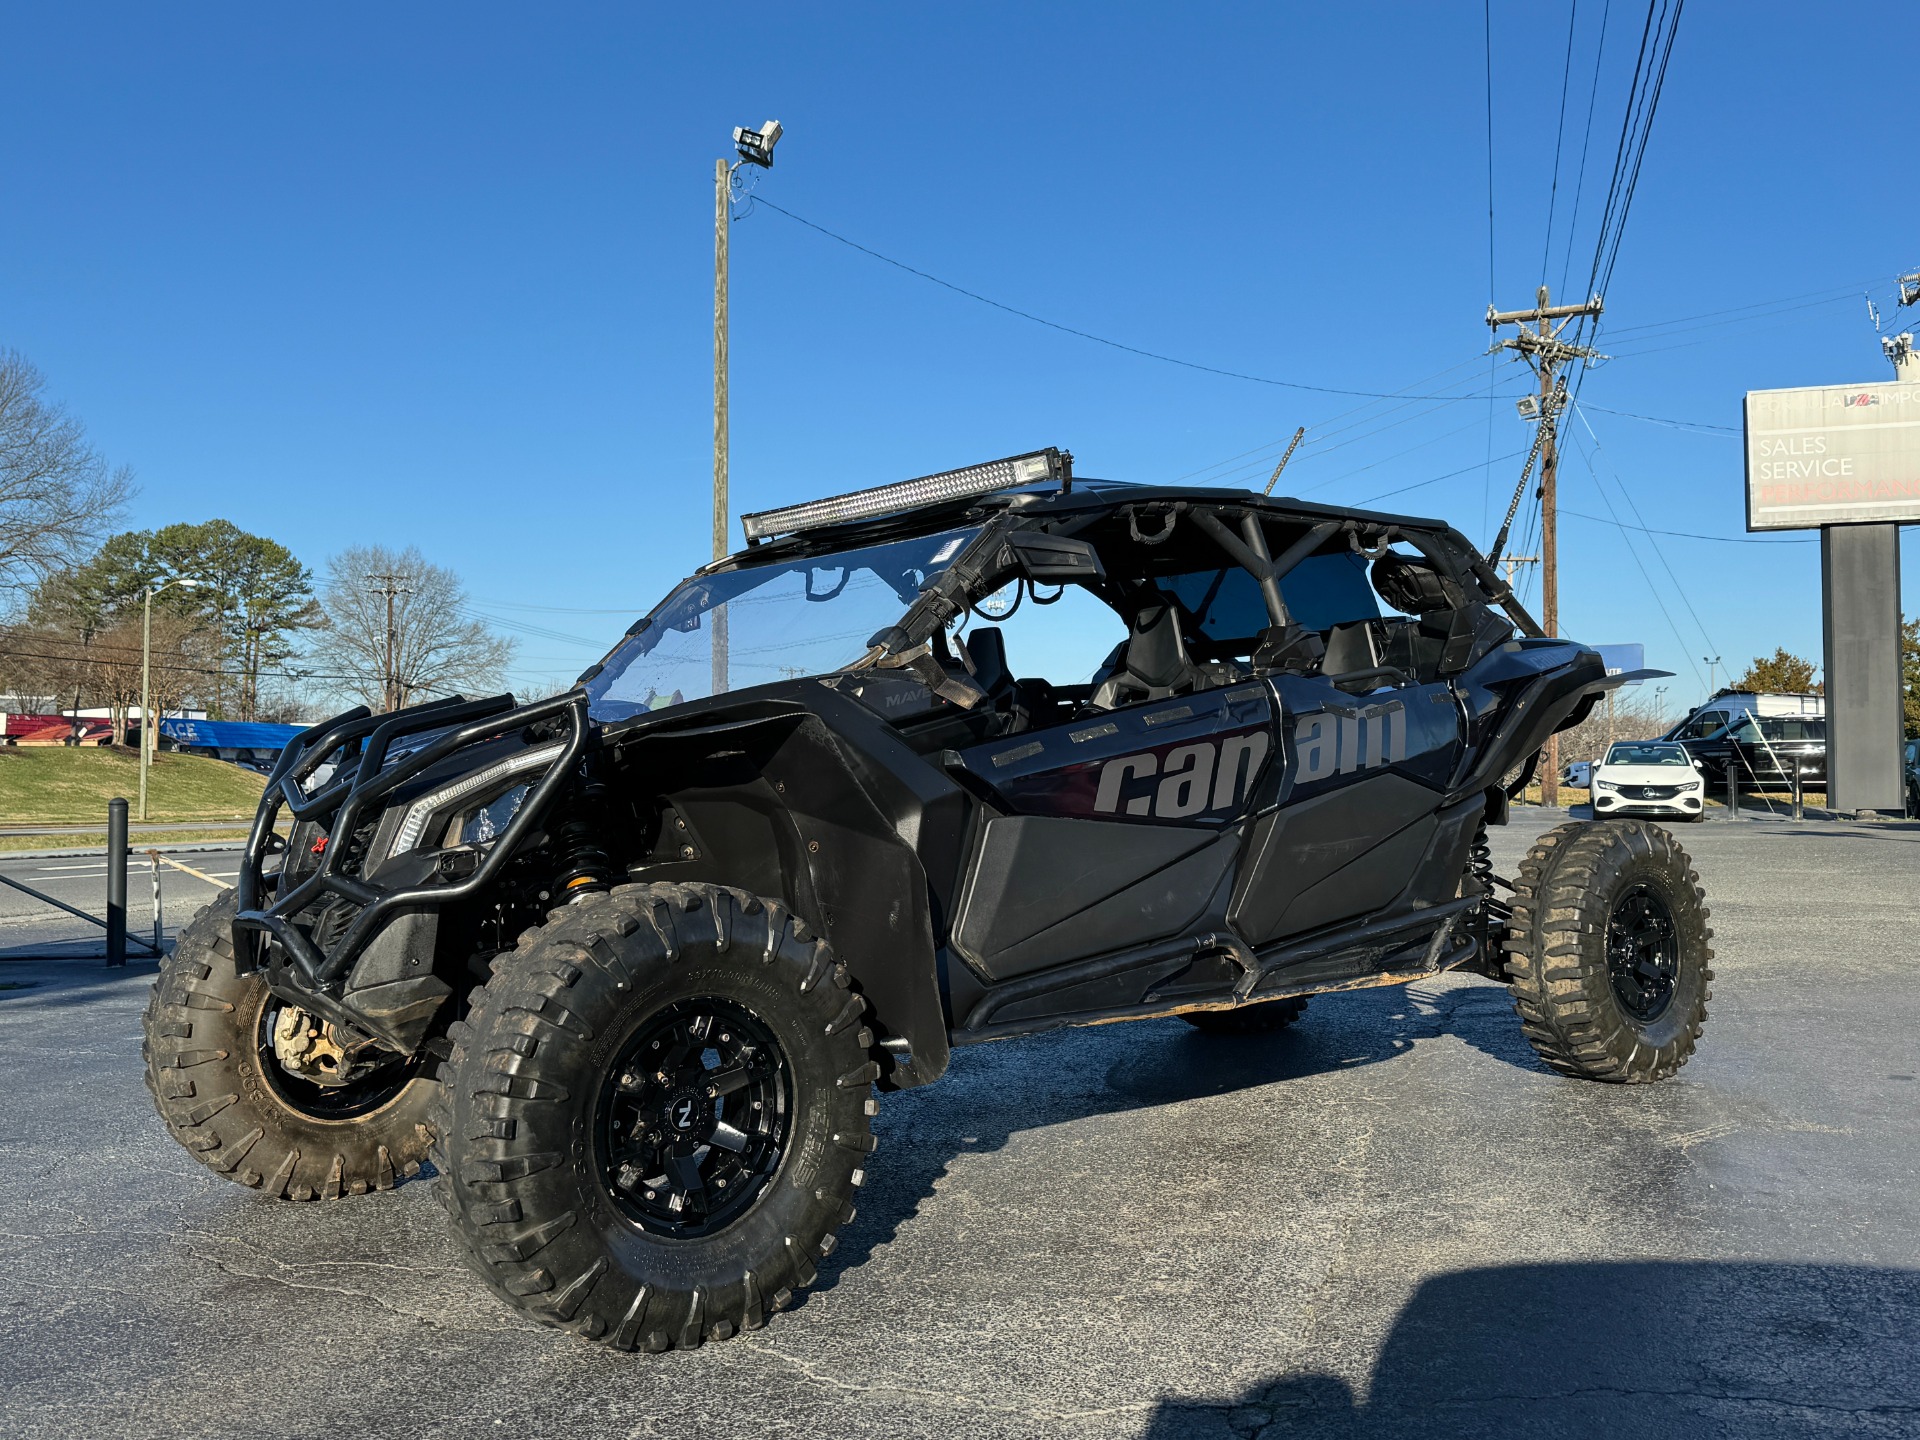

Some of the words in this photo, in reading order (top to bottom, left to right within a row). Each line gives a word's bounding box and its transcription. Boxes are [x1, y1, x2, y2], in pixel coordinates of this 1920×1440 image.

[1760, 436, 1827, 457] SALES
[1760, 458, 1854, 480] SERVICE
[166, 722, 198, 738] ACE
